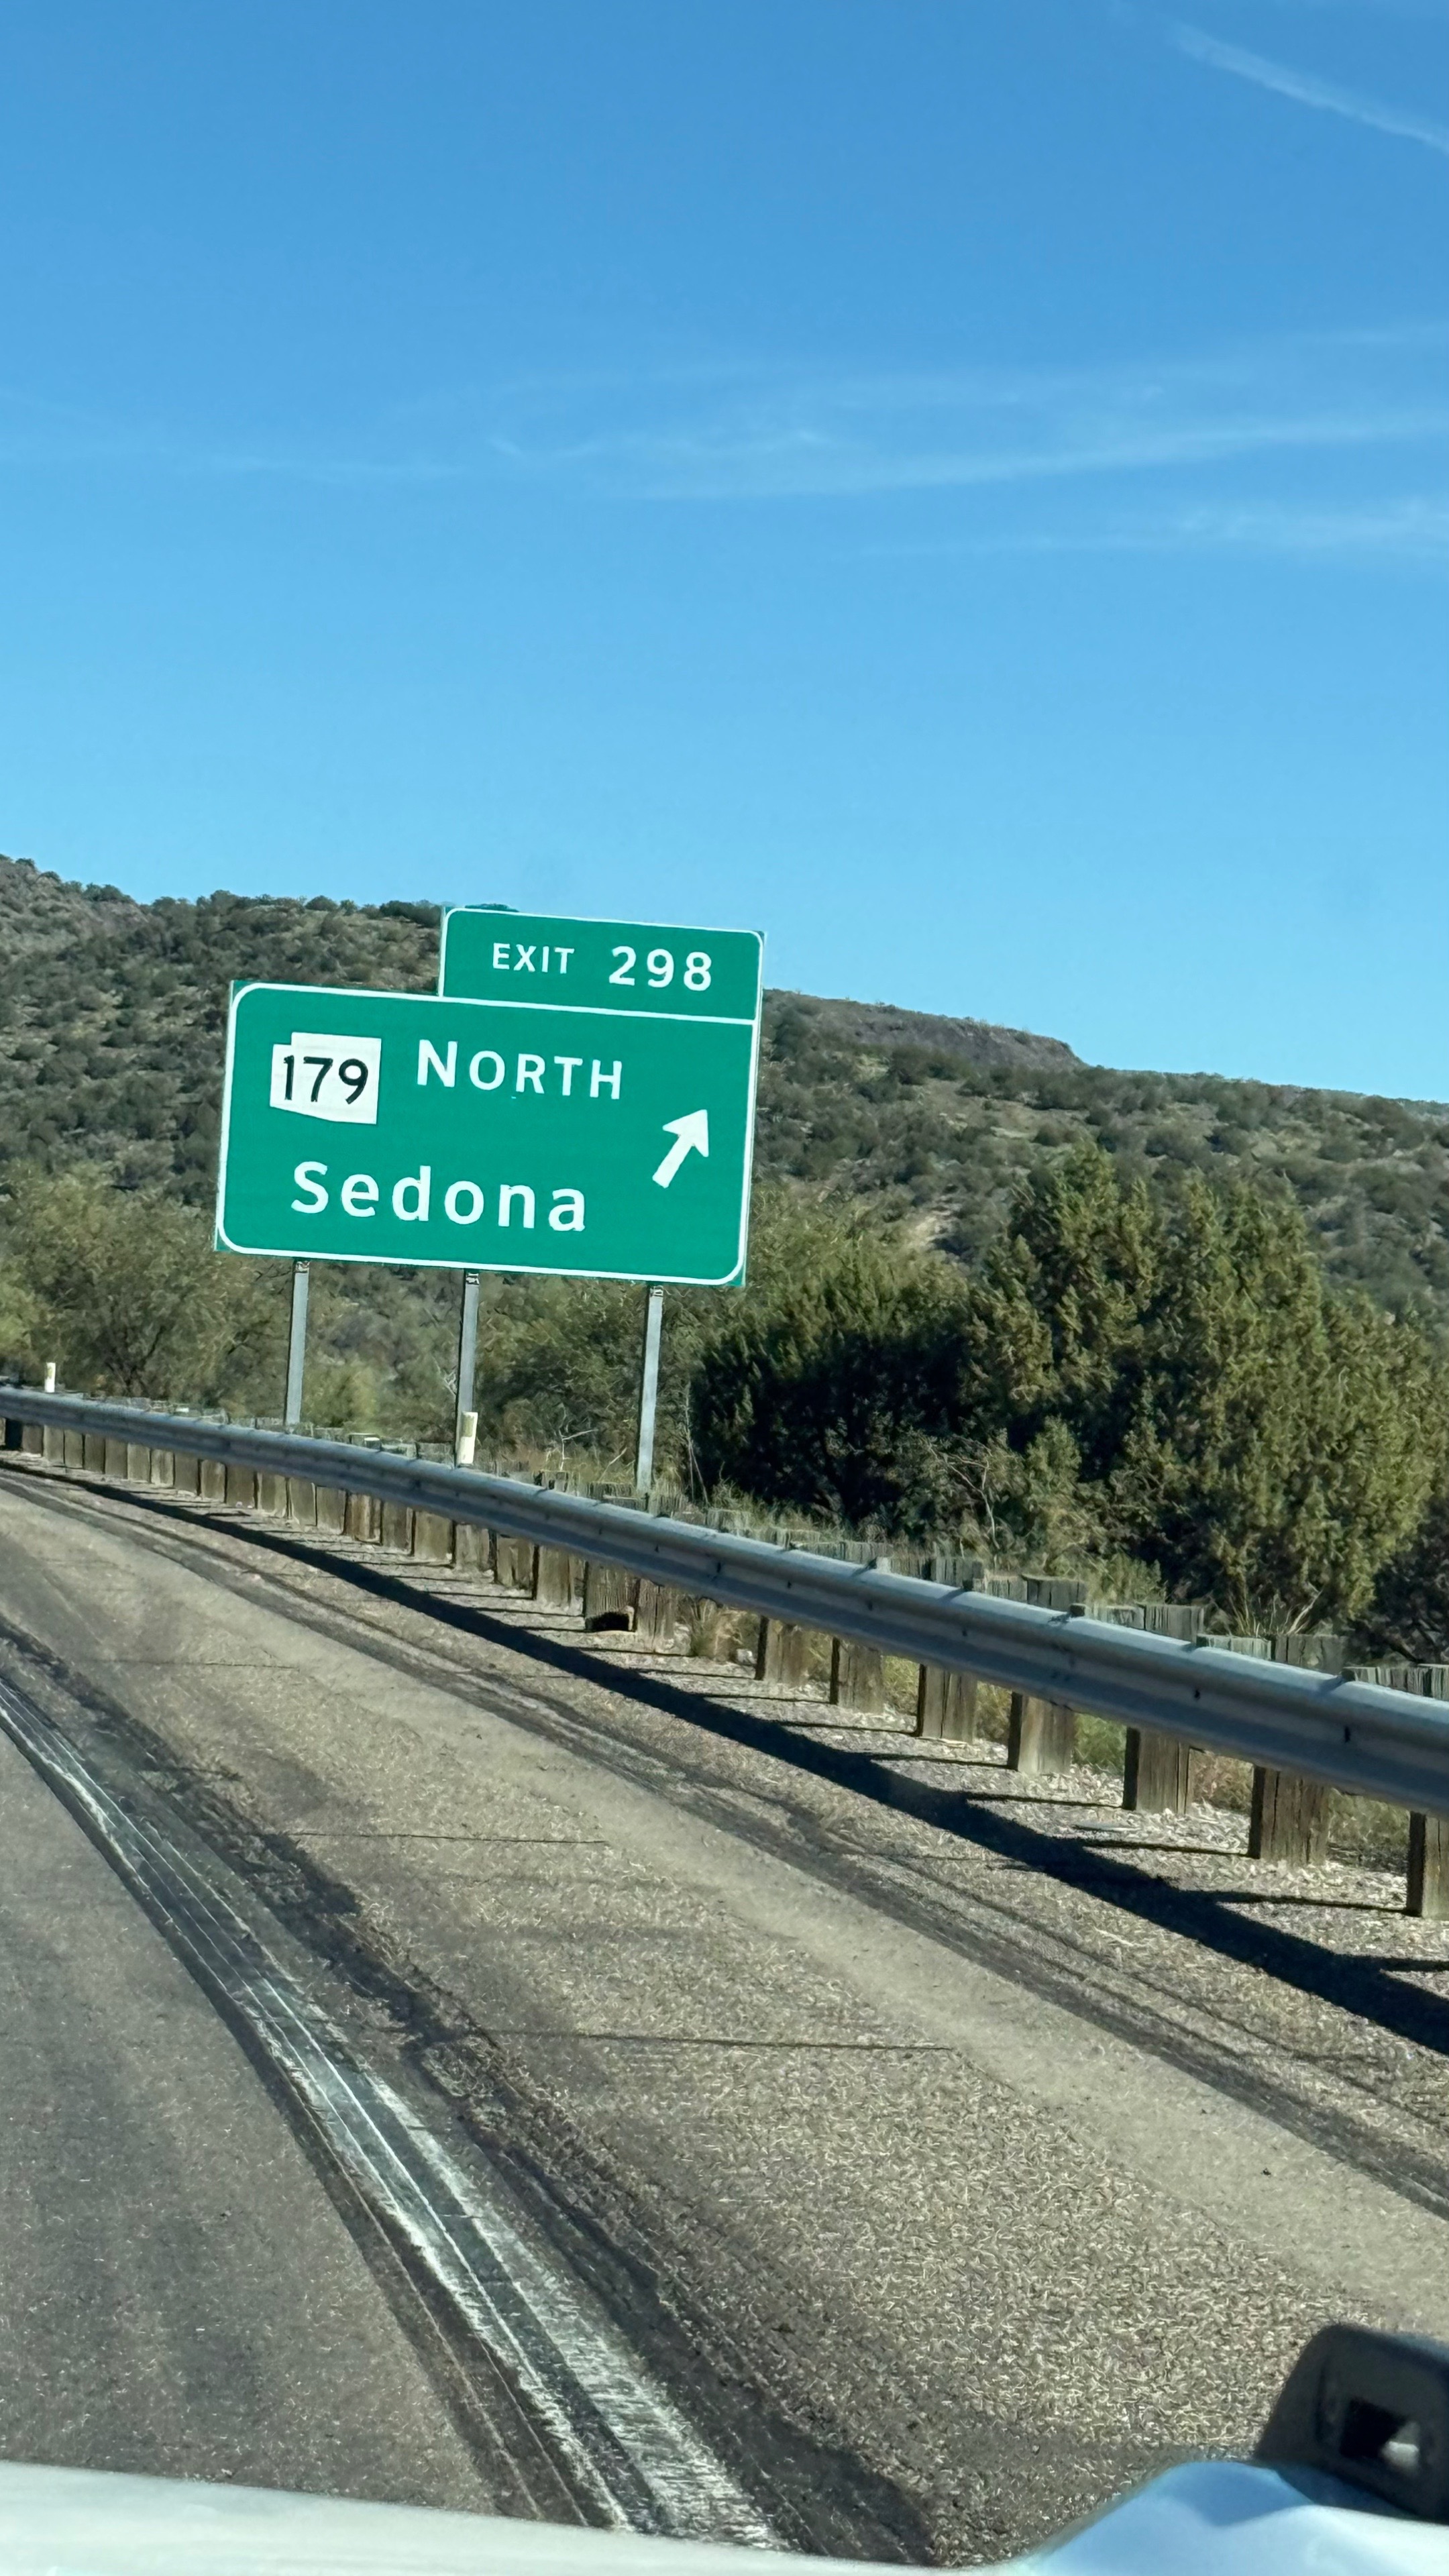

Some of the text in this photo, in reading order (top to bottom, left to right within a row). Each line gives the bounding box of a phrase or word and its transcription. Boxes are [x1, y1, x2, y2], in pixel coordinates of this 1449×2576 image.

[492, 943, 712, 991] EXIT 298
[283, 1055, 369, 1105] 179
[417, 1039, 623, 1099] NORTH
[291, 1161, 586, 1232] Sedona
